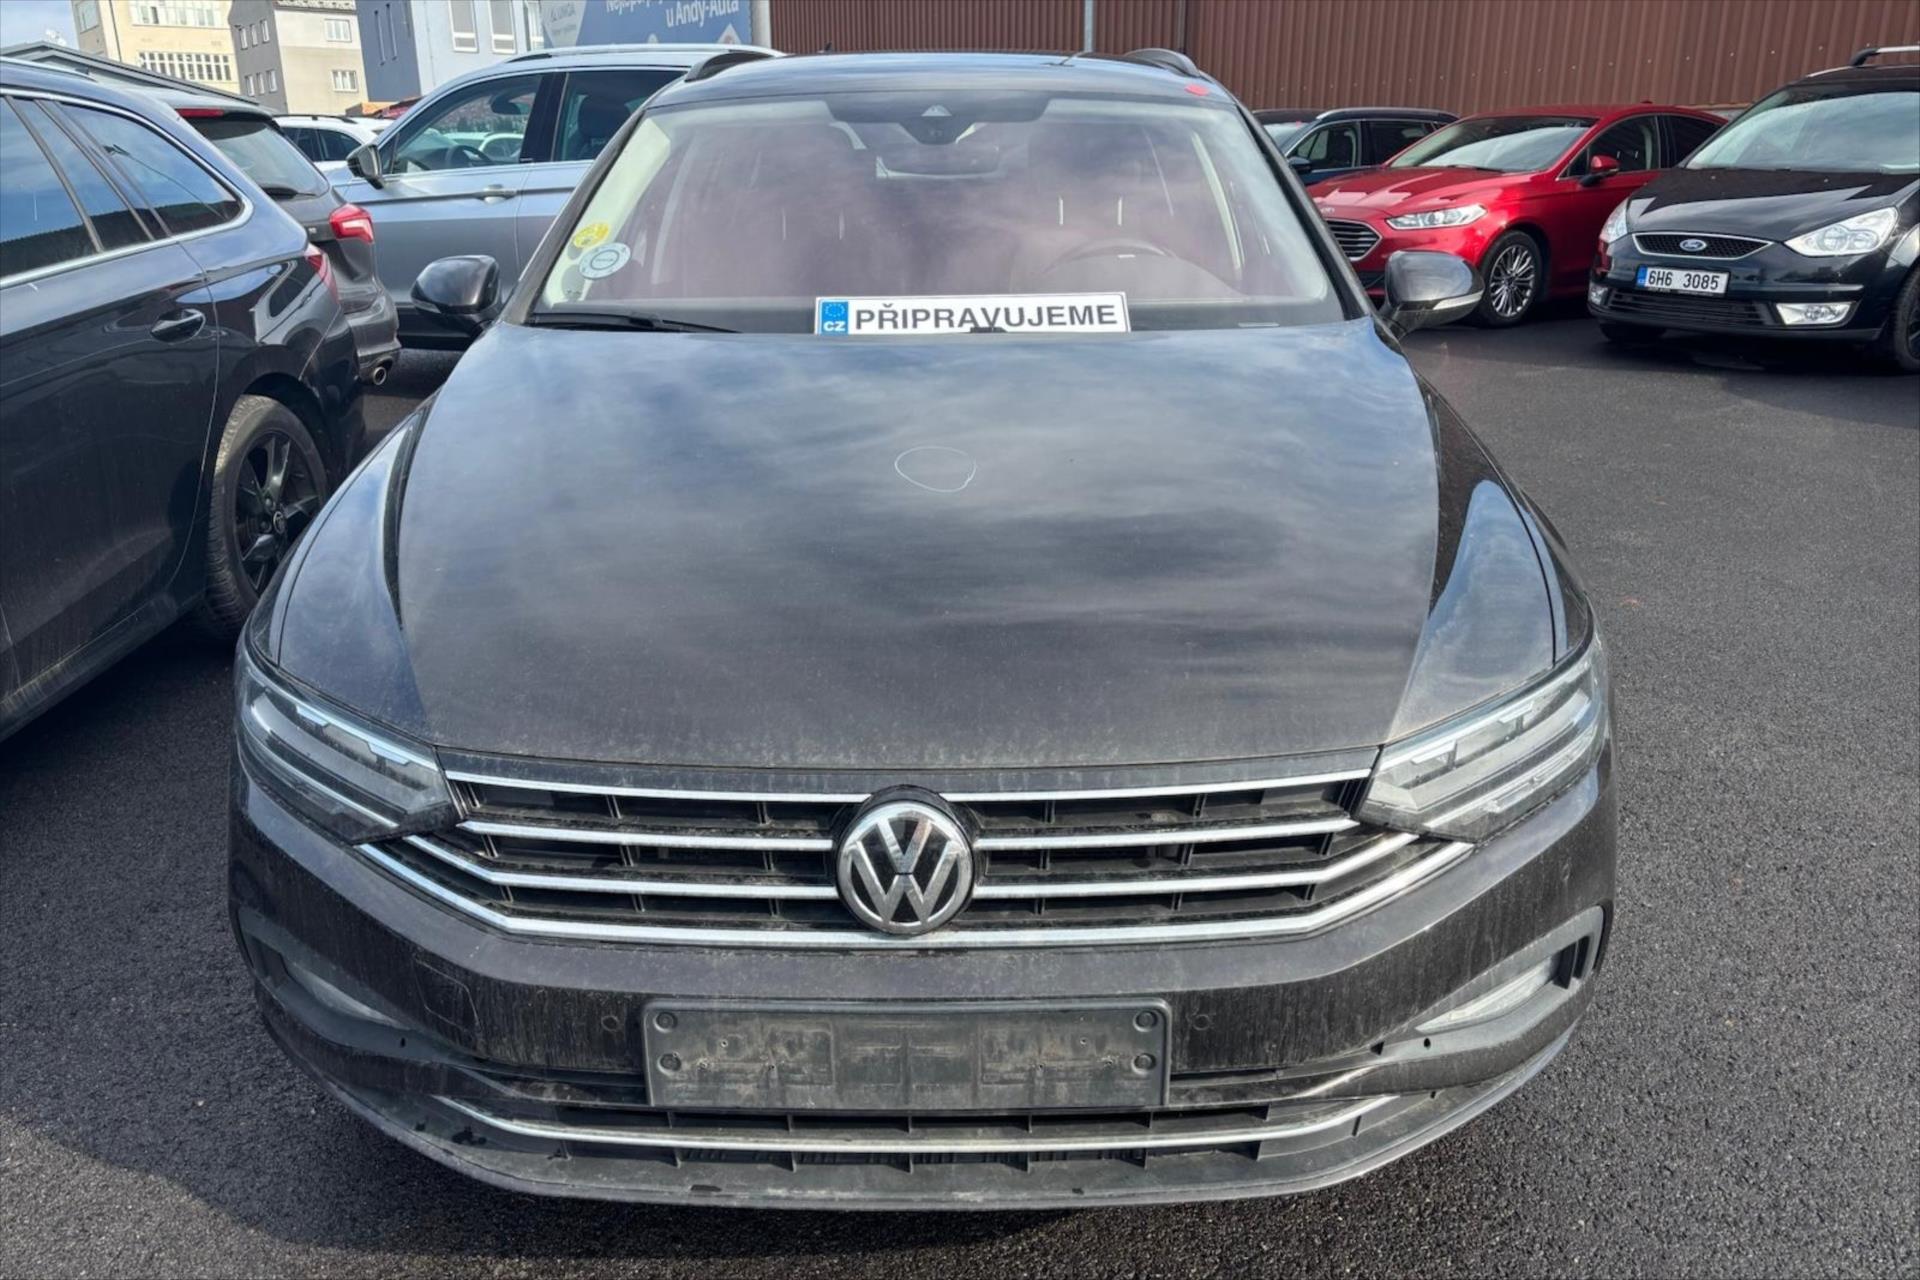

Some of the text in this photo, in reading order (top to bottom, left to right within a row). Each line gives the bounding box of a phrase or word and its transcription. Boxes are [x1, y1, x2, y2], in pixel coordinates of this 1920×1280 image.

[665, 8, 674, 28] u
[1648, 270, 1673, 286] 6H6
[1683, 273, 1720, 290] 3085
[823, 320, 846, 332] CZ
[855, 303, 1118, 330] PŘIPRAVUJEME
